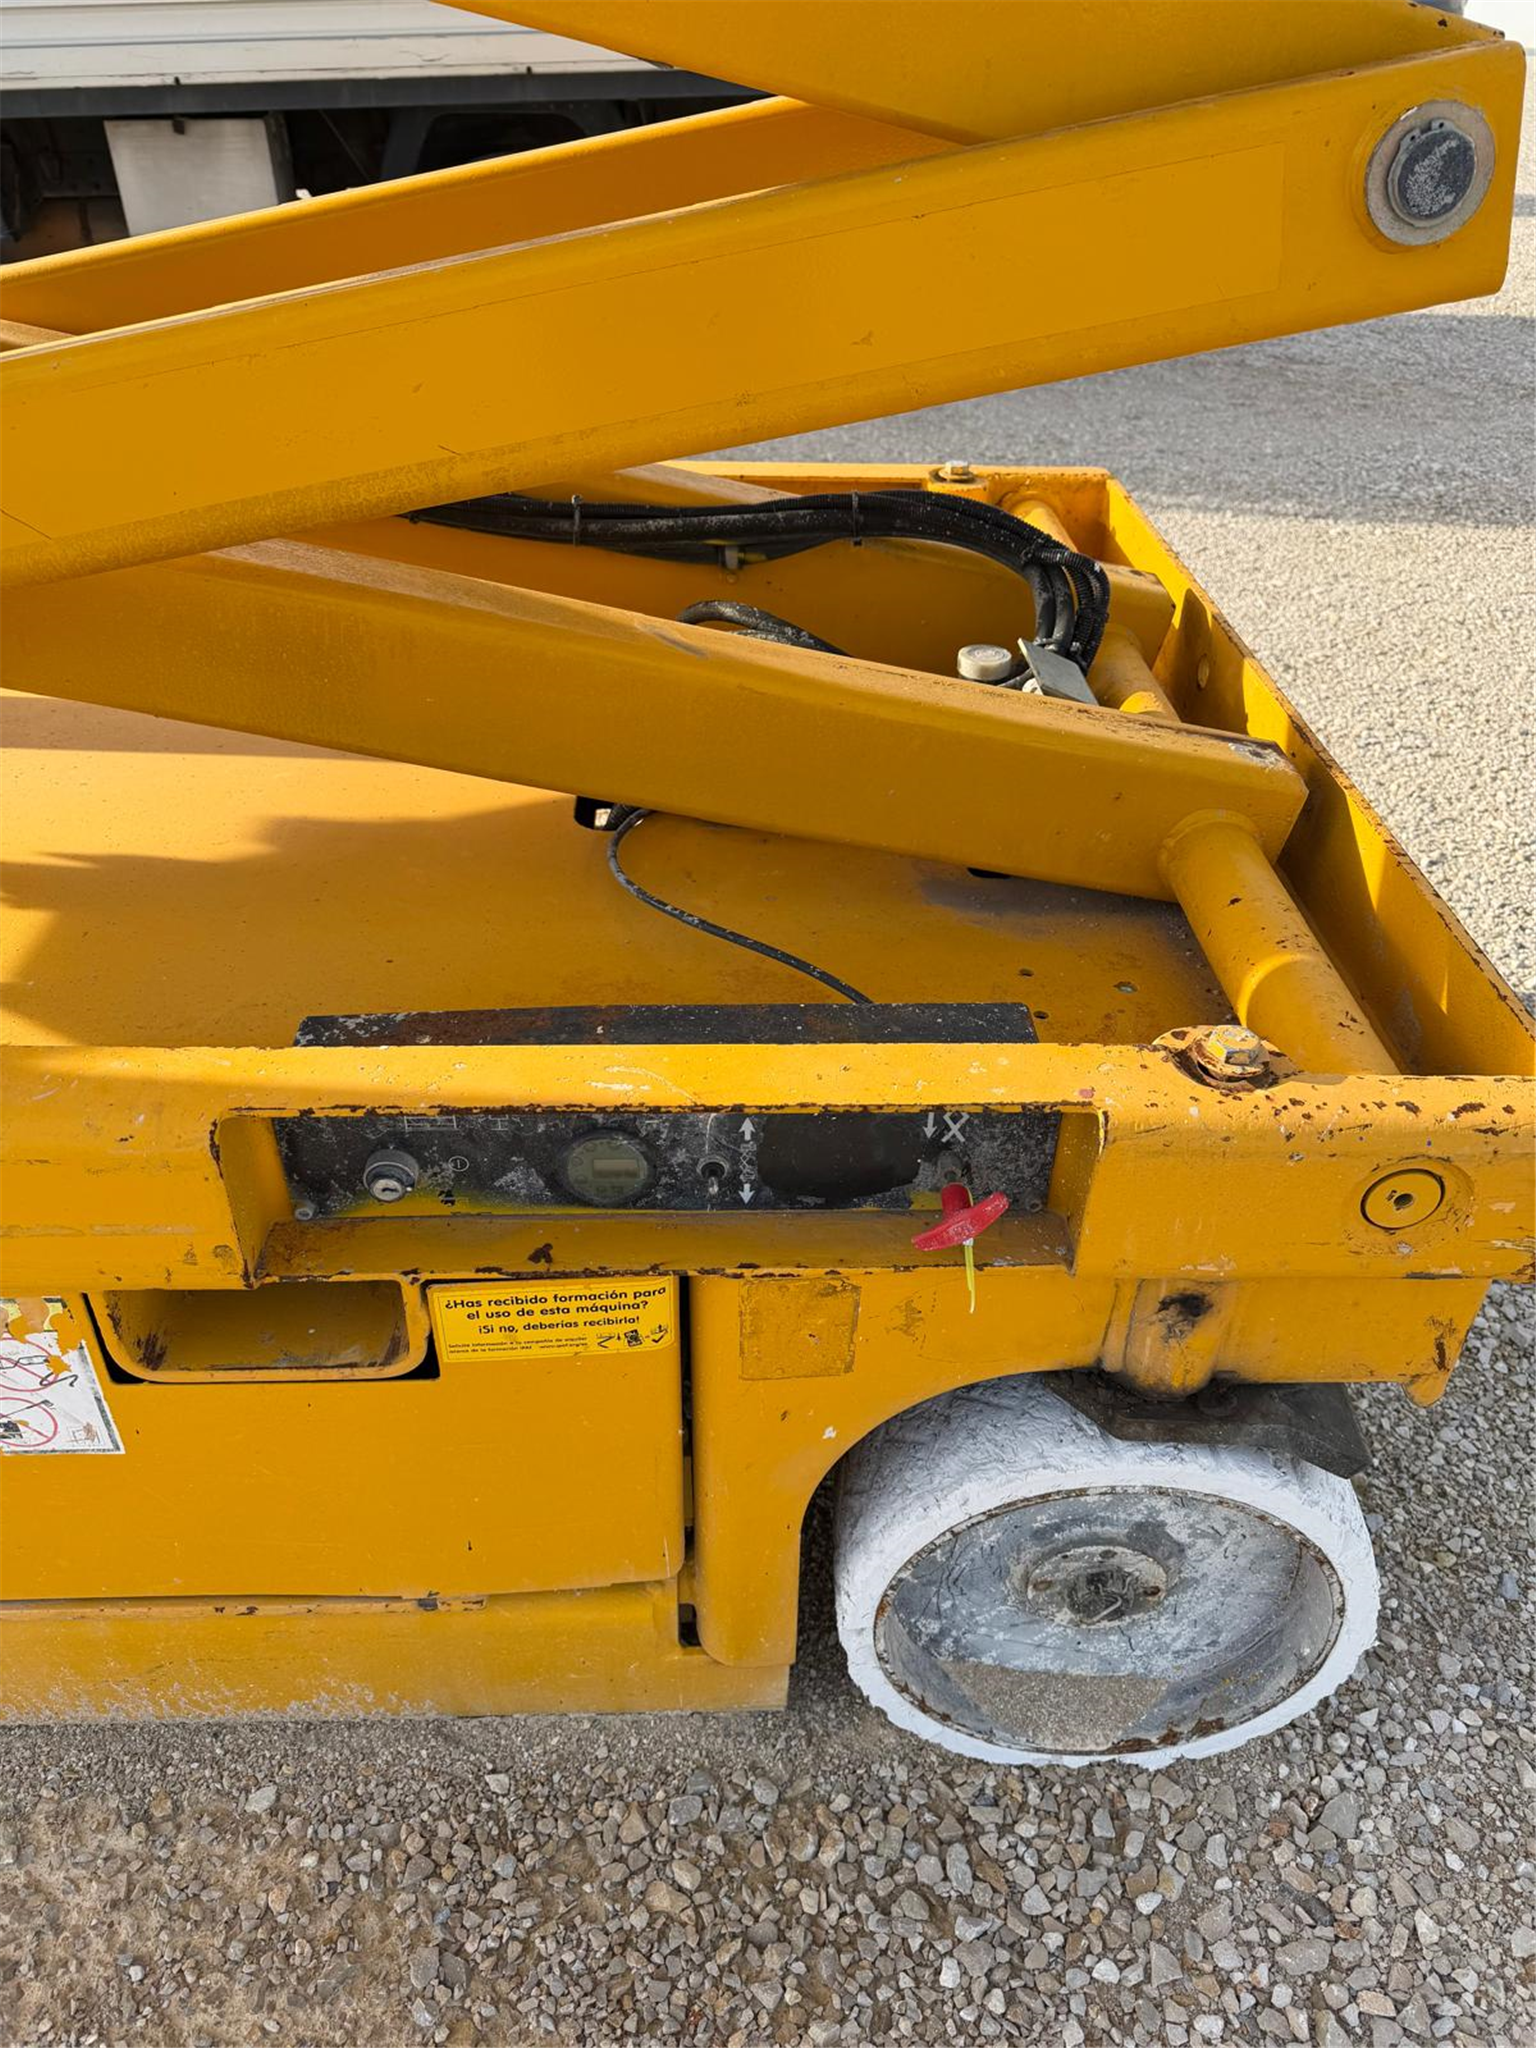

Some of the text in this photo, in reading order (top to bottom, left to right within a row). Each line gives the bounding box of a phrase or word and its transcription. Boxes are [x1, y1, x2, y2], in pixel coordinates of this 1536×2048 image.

[445, 1286, 666, 1309] ¿Has recibido formación para
[466, 1300, 649, 1320] el uso de esta máquina?
[478, 1324, 496, 1335] ¡Si
[499, 1324, 519, 1334] no,
[583, 1315, 640, 1327] recibirla!
